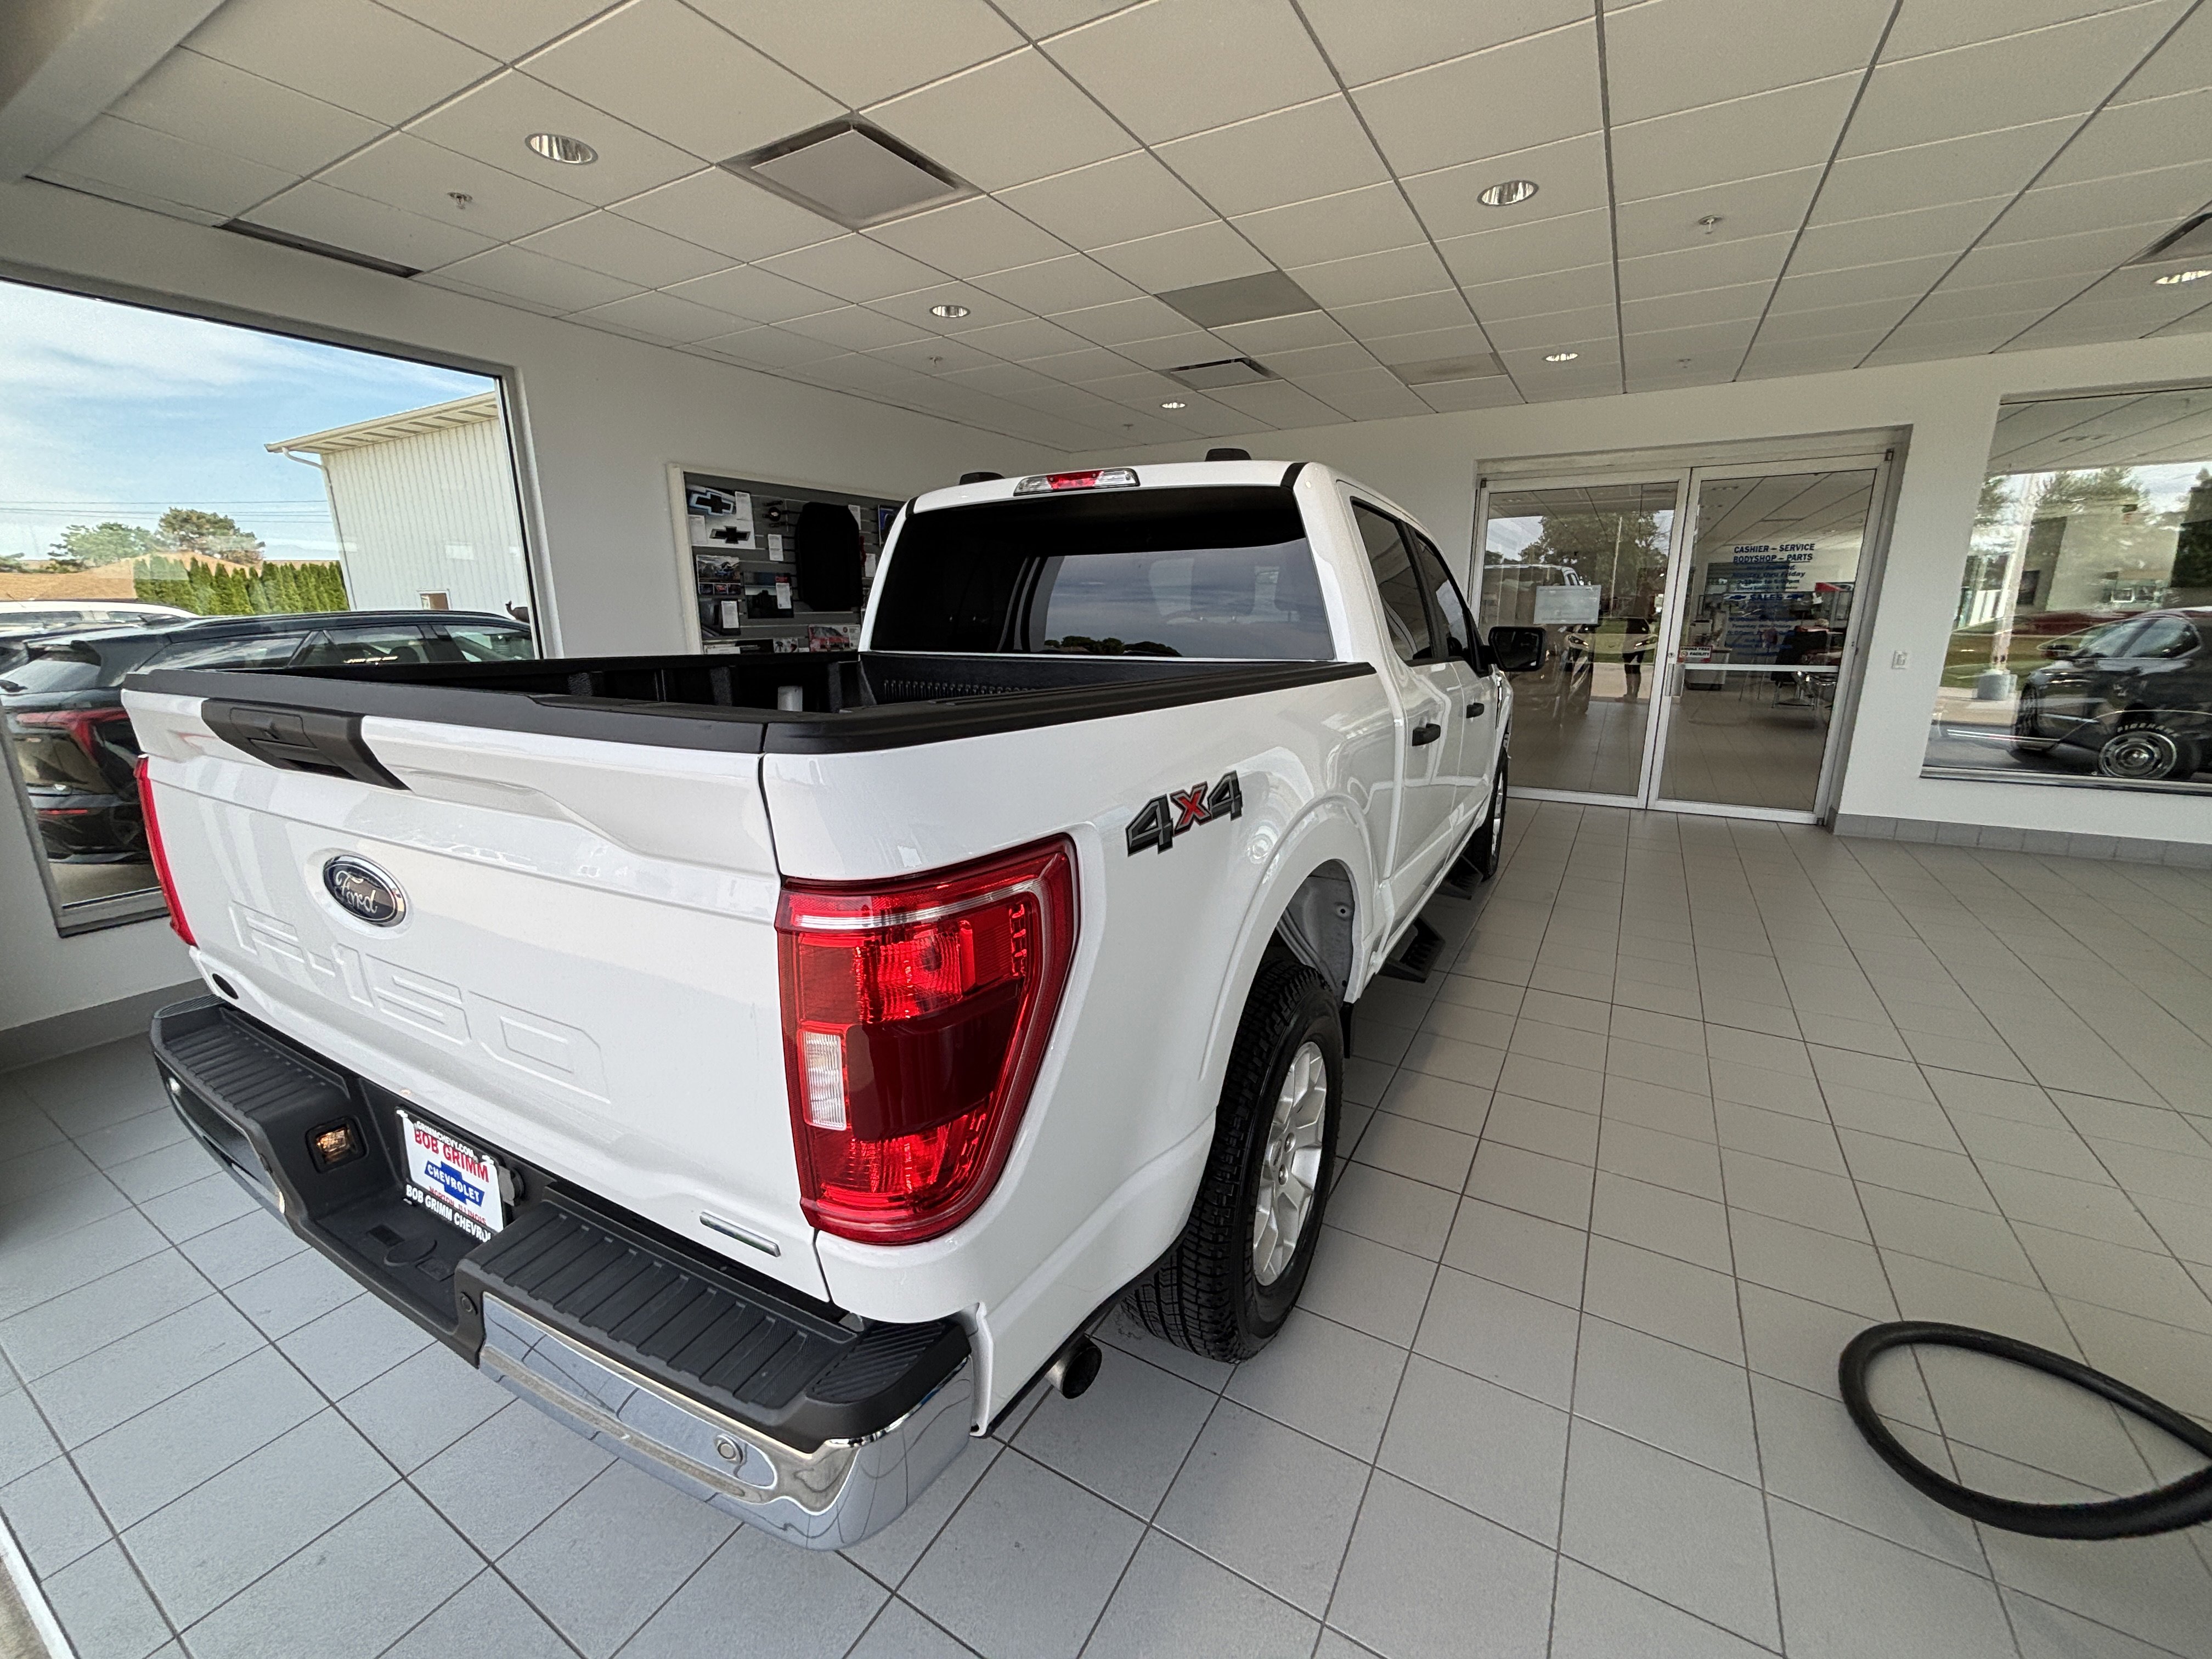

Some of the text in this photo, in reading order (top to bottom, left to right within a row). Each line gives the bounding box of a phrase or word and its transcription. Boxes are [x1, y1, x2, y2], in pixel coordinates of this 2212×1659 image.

[1733, 555, 1777, 563] BODYSHOP
[1786, 553, 1813, 562] PARTS
[1734, 545, 1770, 554] CASHIER
[1779, 543, 1816, 552] SERVICE
[335, 870, 378, 914] Ford
[229, 900, 611, 1103] F-150
[414, 1129, 490, 1183] BOB GRIMM
[416, 1121, 475, 1158] GRIMMCHEVY.COM
[427, 1164, 479, 1203] CHEVROLET
[406, 1184, 424, 1203] BOB
[425, 1195, 453, 1221] GRIMM
[458, 1204, 487, 1224] ILLINOIS
